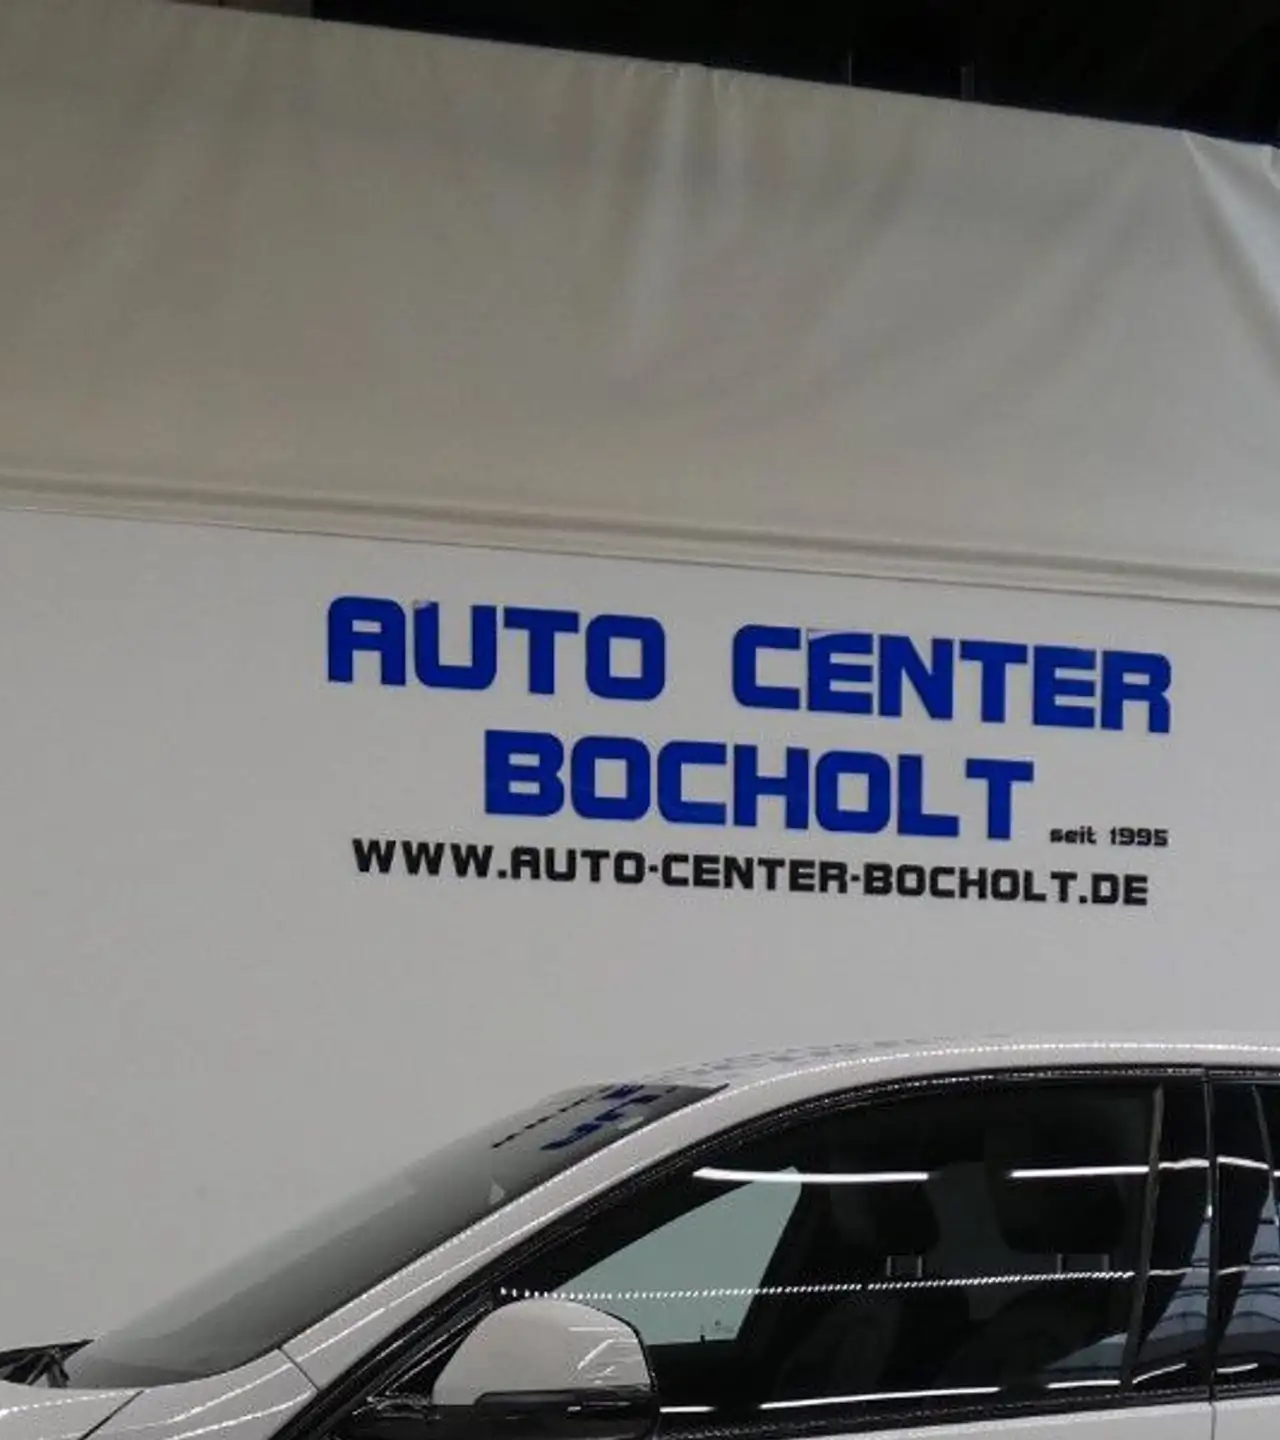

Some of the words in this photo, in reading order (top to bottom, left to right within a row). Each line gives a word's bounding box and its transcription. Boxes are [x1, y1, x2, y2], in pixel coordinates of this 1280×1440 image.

[326, 595, 667, 702] AUTO
[731, 623, 1172, 733] CENTER
[484, 729, 1034, 841] BOCHOLT
[1049, 825, 1098, 846] seit
[1109, 826, 1170, 848] 1995
[351, 838, 1151, 907] WWW.AUTO-CENTER-BOCHOLT.DE
